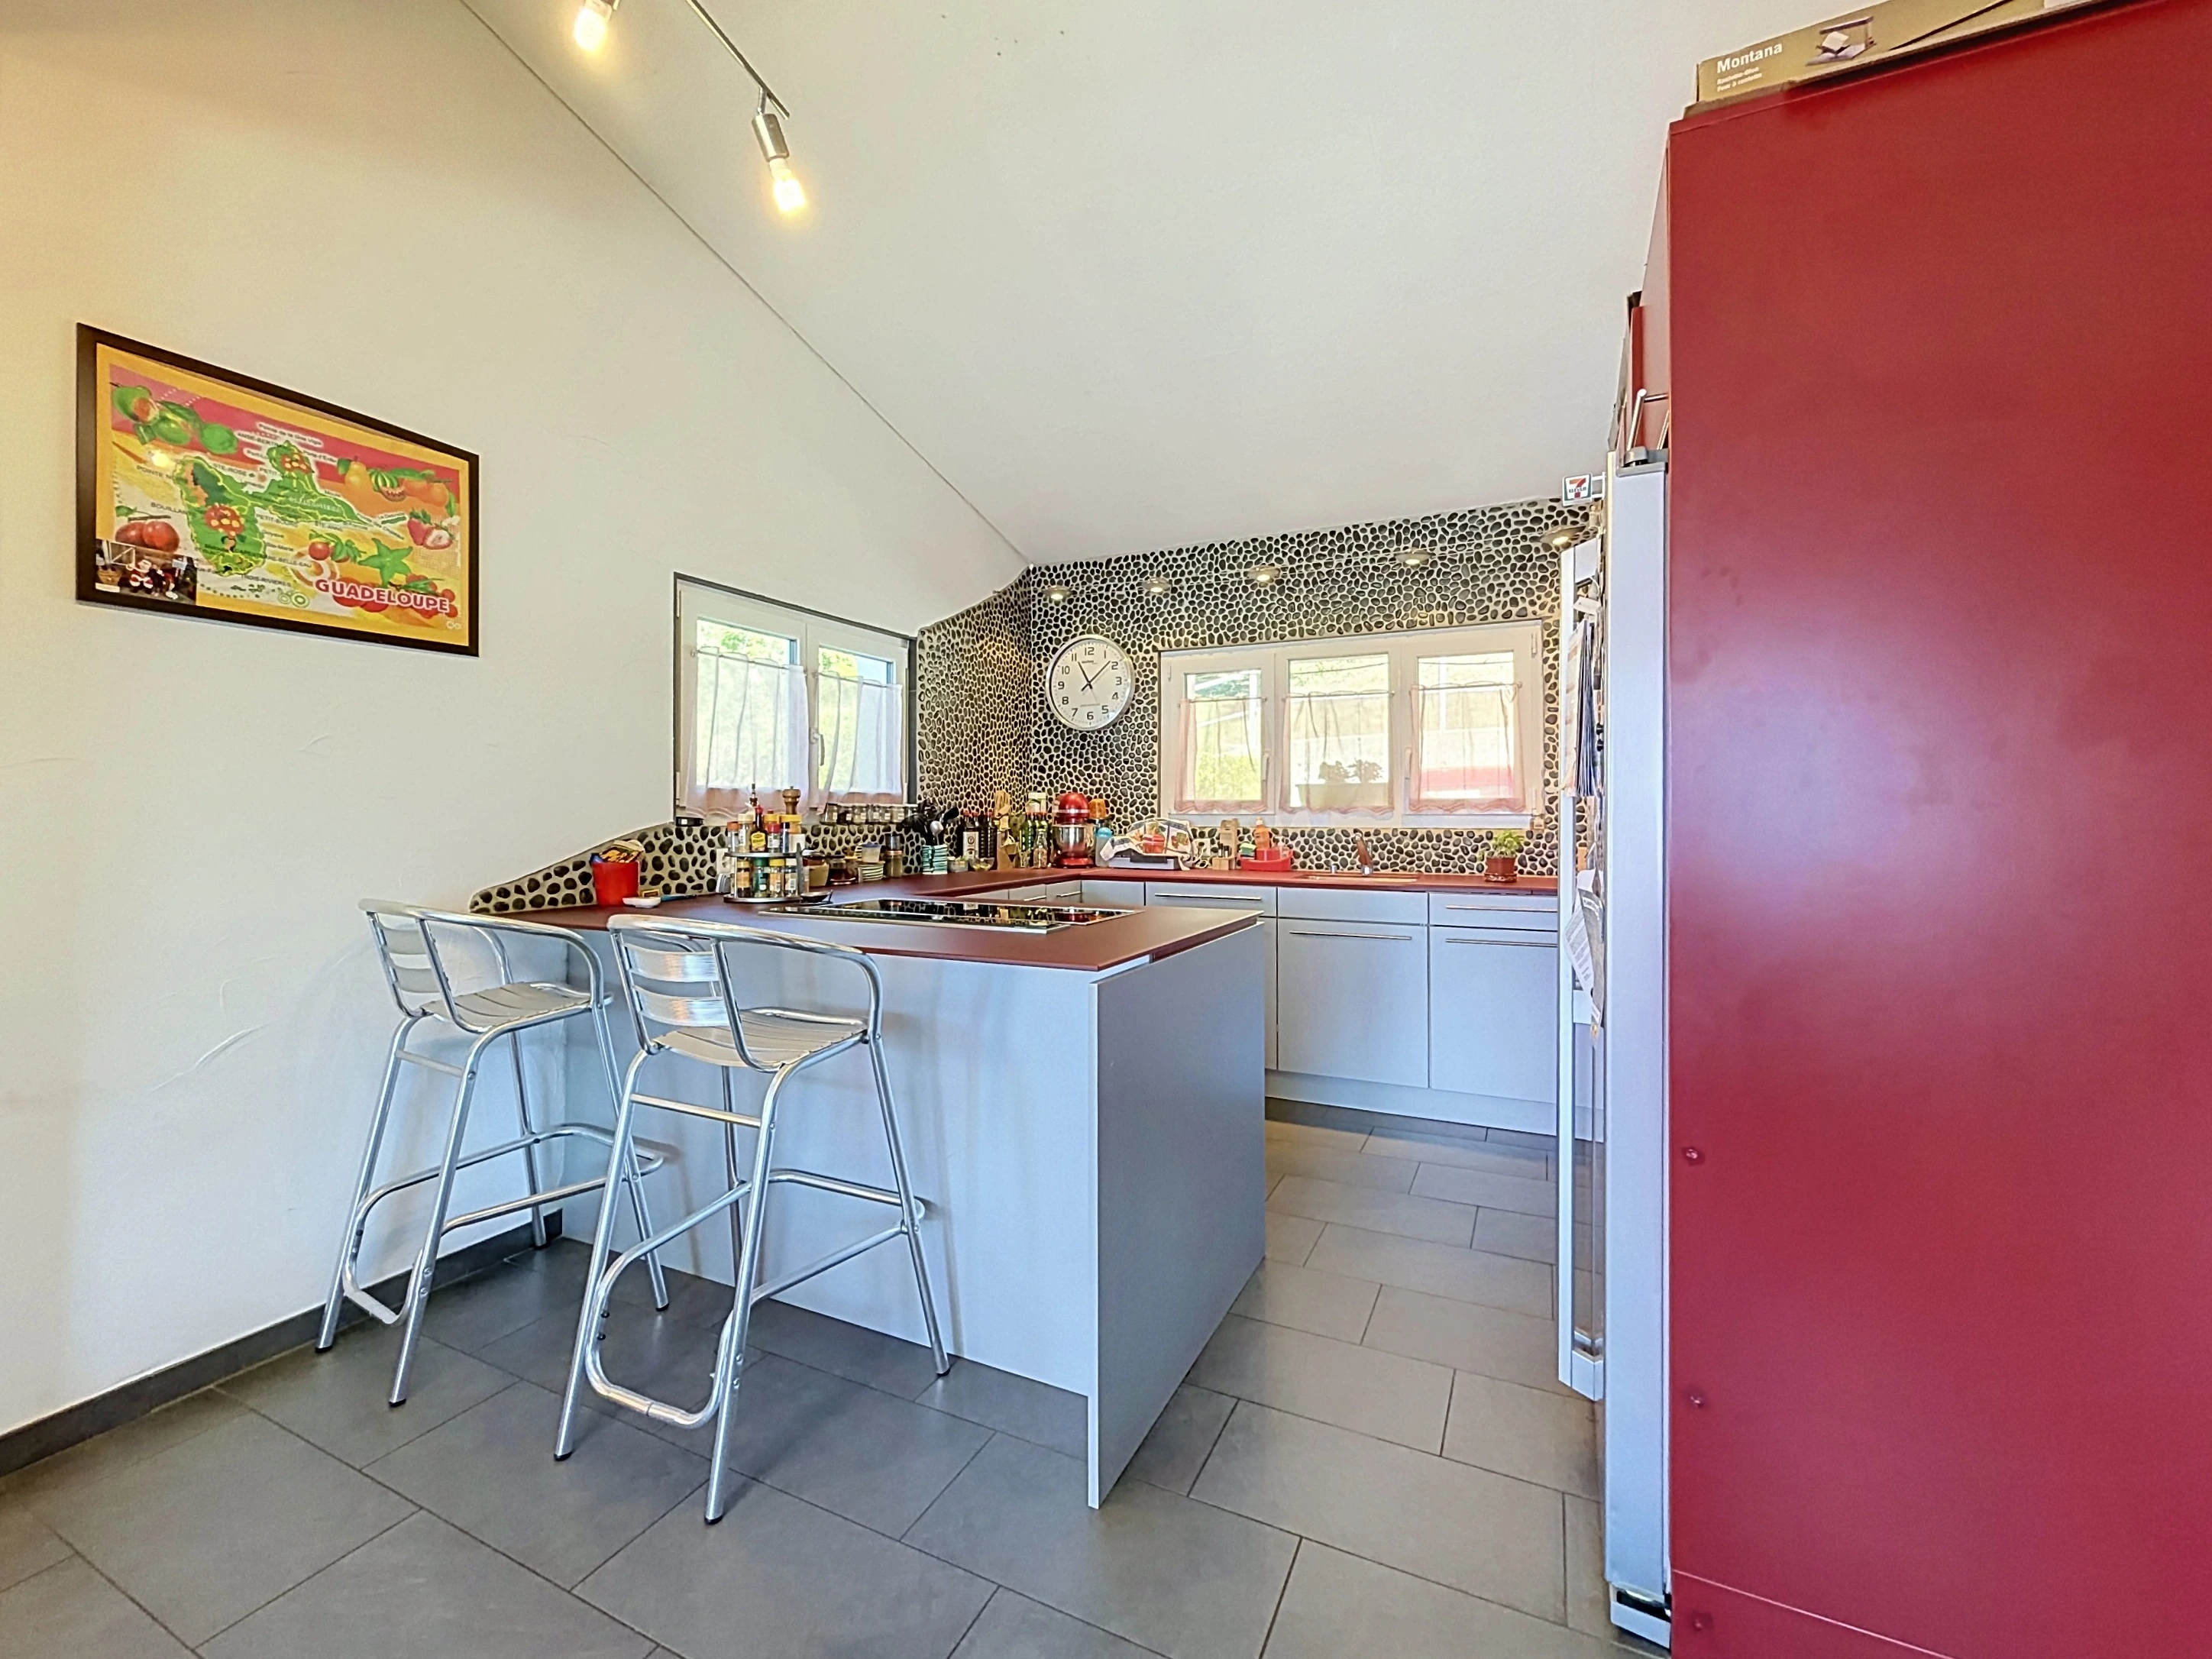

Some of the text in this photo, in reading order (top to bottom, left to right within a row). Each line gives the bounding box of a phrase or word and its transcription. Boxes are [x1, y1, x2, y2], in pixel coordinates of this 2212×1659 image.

[1717, 44, 1783, 73] Montana
[315, 579, 449, 611] GUADELOUPE
[1085, 646, 1095, 655] 12
[1071, 653, 1077, 661] 11
[1061, 666, 1070, 674] 10
[1111, 661, 1119, 670] 2
[1058, 681, 1065, 690] 9
[1115, 677, 1122, 685] 3
[1062, 696, 1069, 705] 8
[1111, 692, 1119, 700] 4
[1072, 707, 1079, 716] 7
[1101, 705, 1109, 714] 5
[1086, 711, 1094, 720] 6
